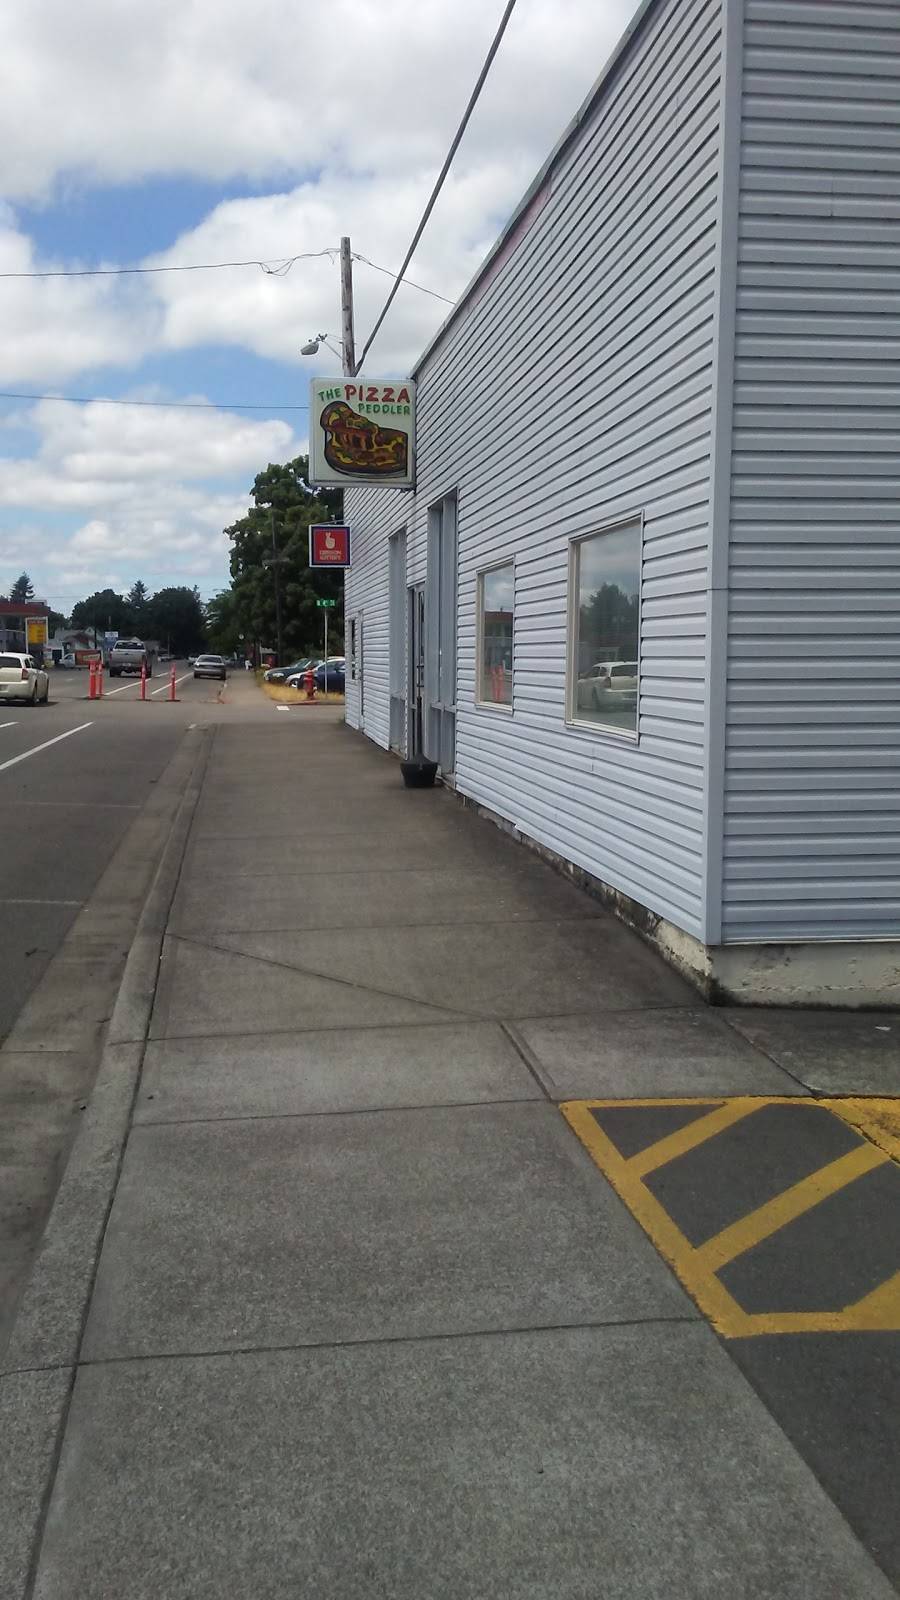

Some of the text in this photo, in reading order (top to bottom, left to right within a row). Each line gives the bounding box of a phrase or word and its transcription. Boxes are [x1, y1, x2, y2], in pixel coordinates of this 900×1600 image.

[318, 384, 410, 404] THE PIZZA
[358, 403, 410, 416] PEDDLER
